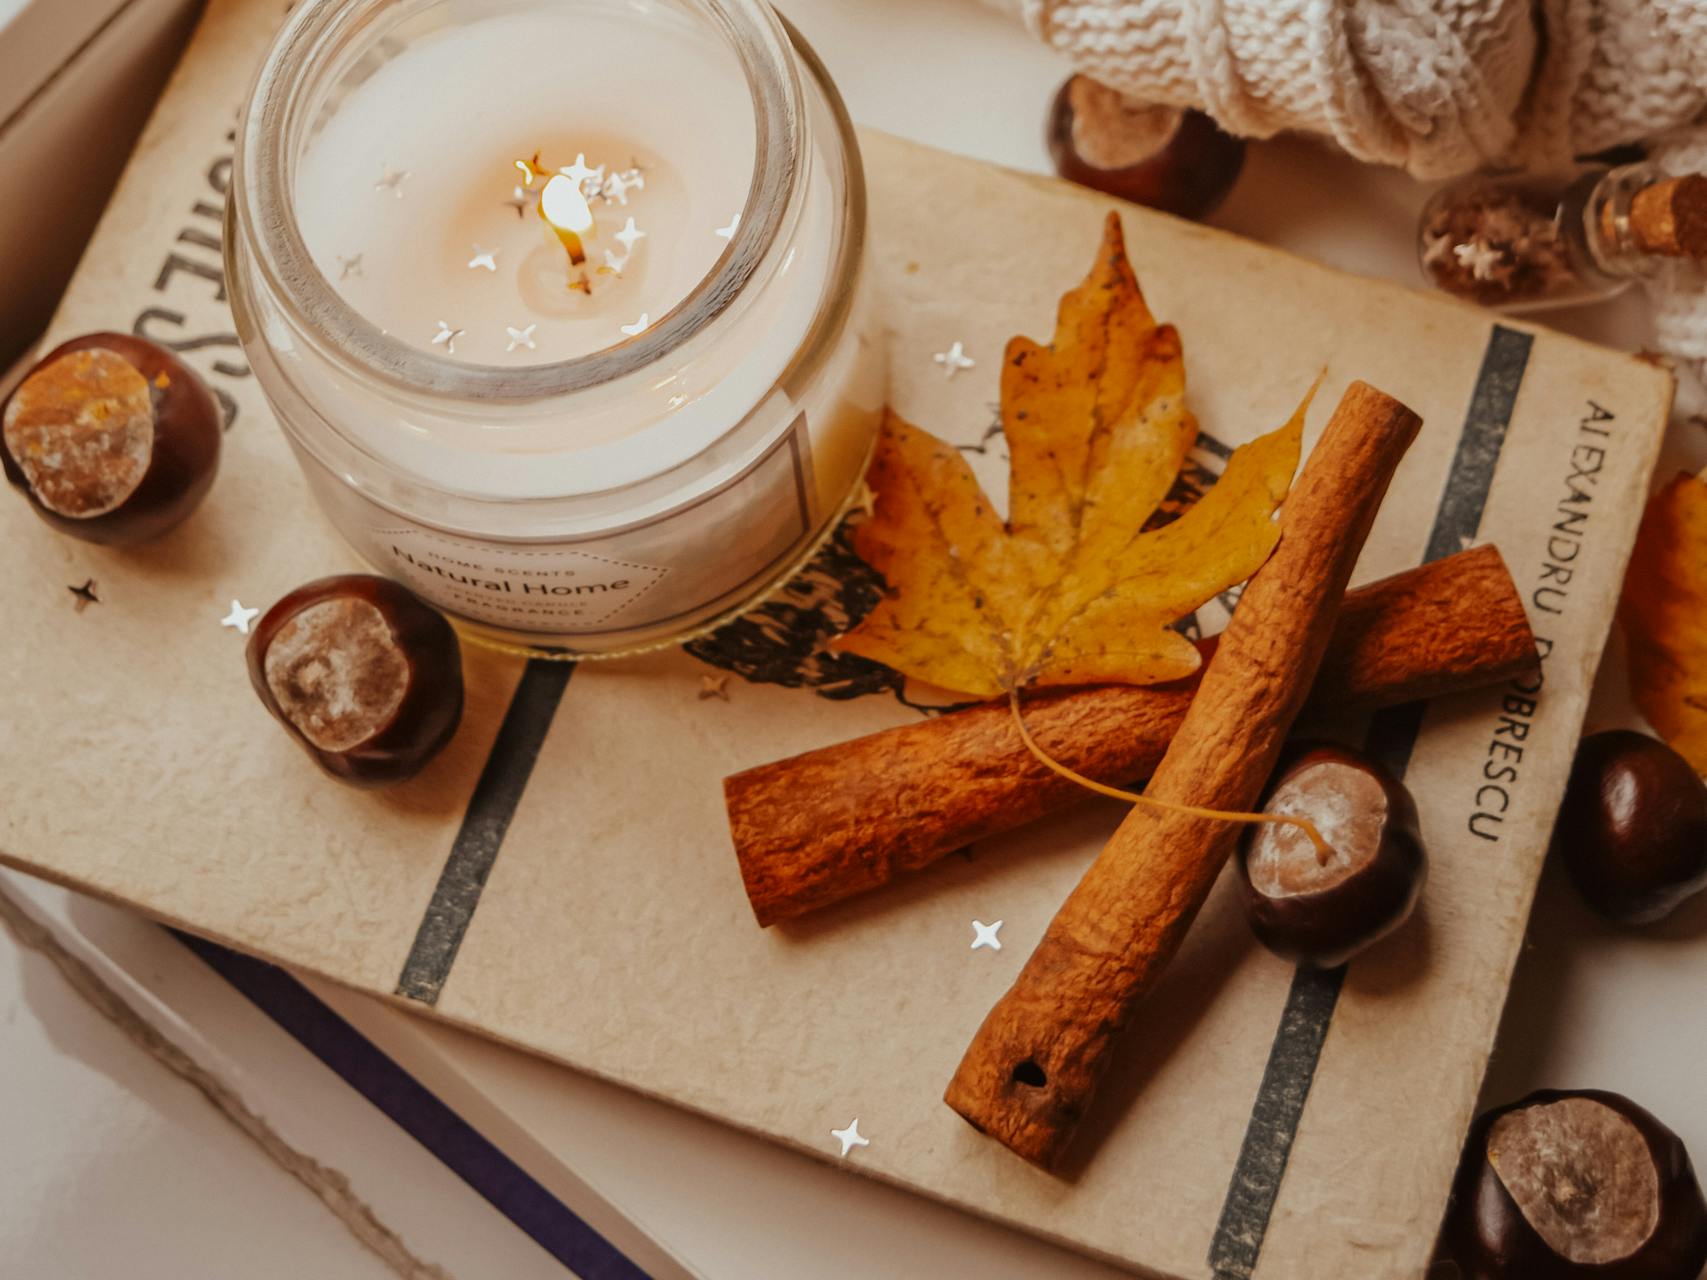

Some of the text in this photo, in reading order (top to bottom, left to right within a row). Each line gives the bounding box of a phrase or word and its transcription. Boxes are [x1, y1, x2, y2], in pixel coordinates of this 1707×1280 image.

[392, 545, 630, 595] Natural Home
[494, 567, 576, 577] SCENTS
[453, 593, 584, 616] FRAGRANCE
